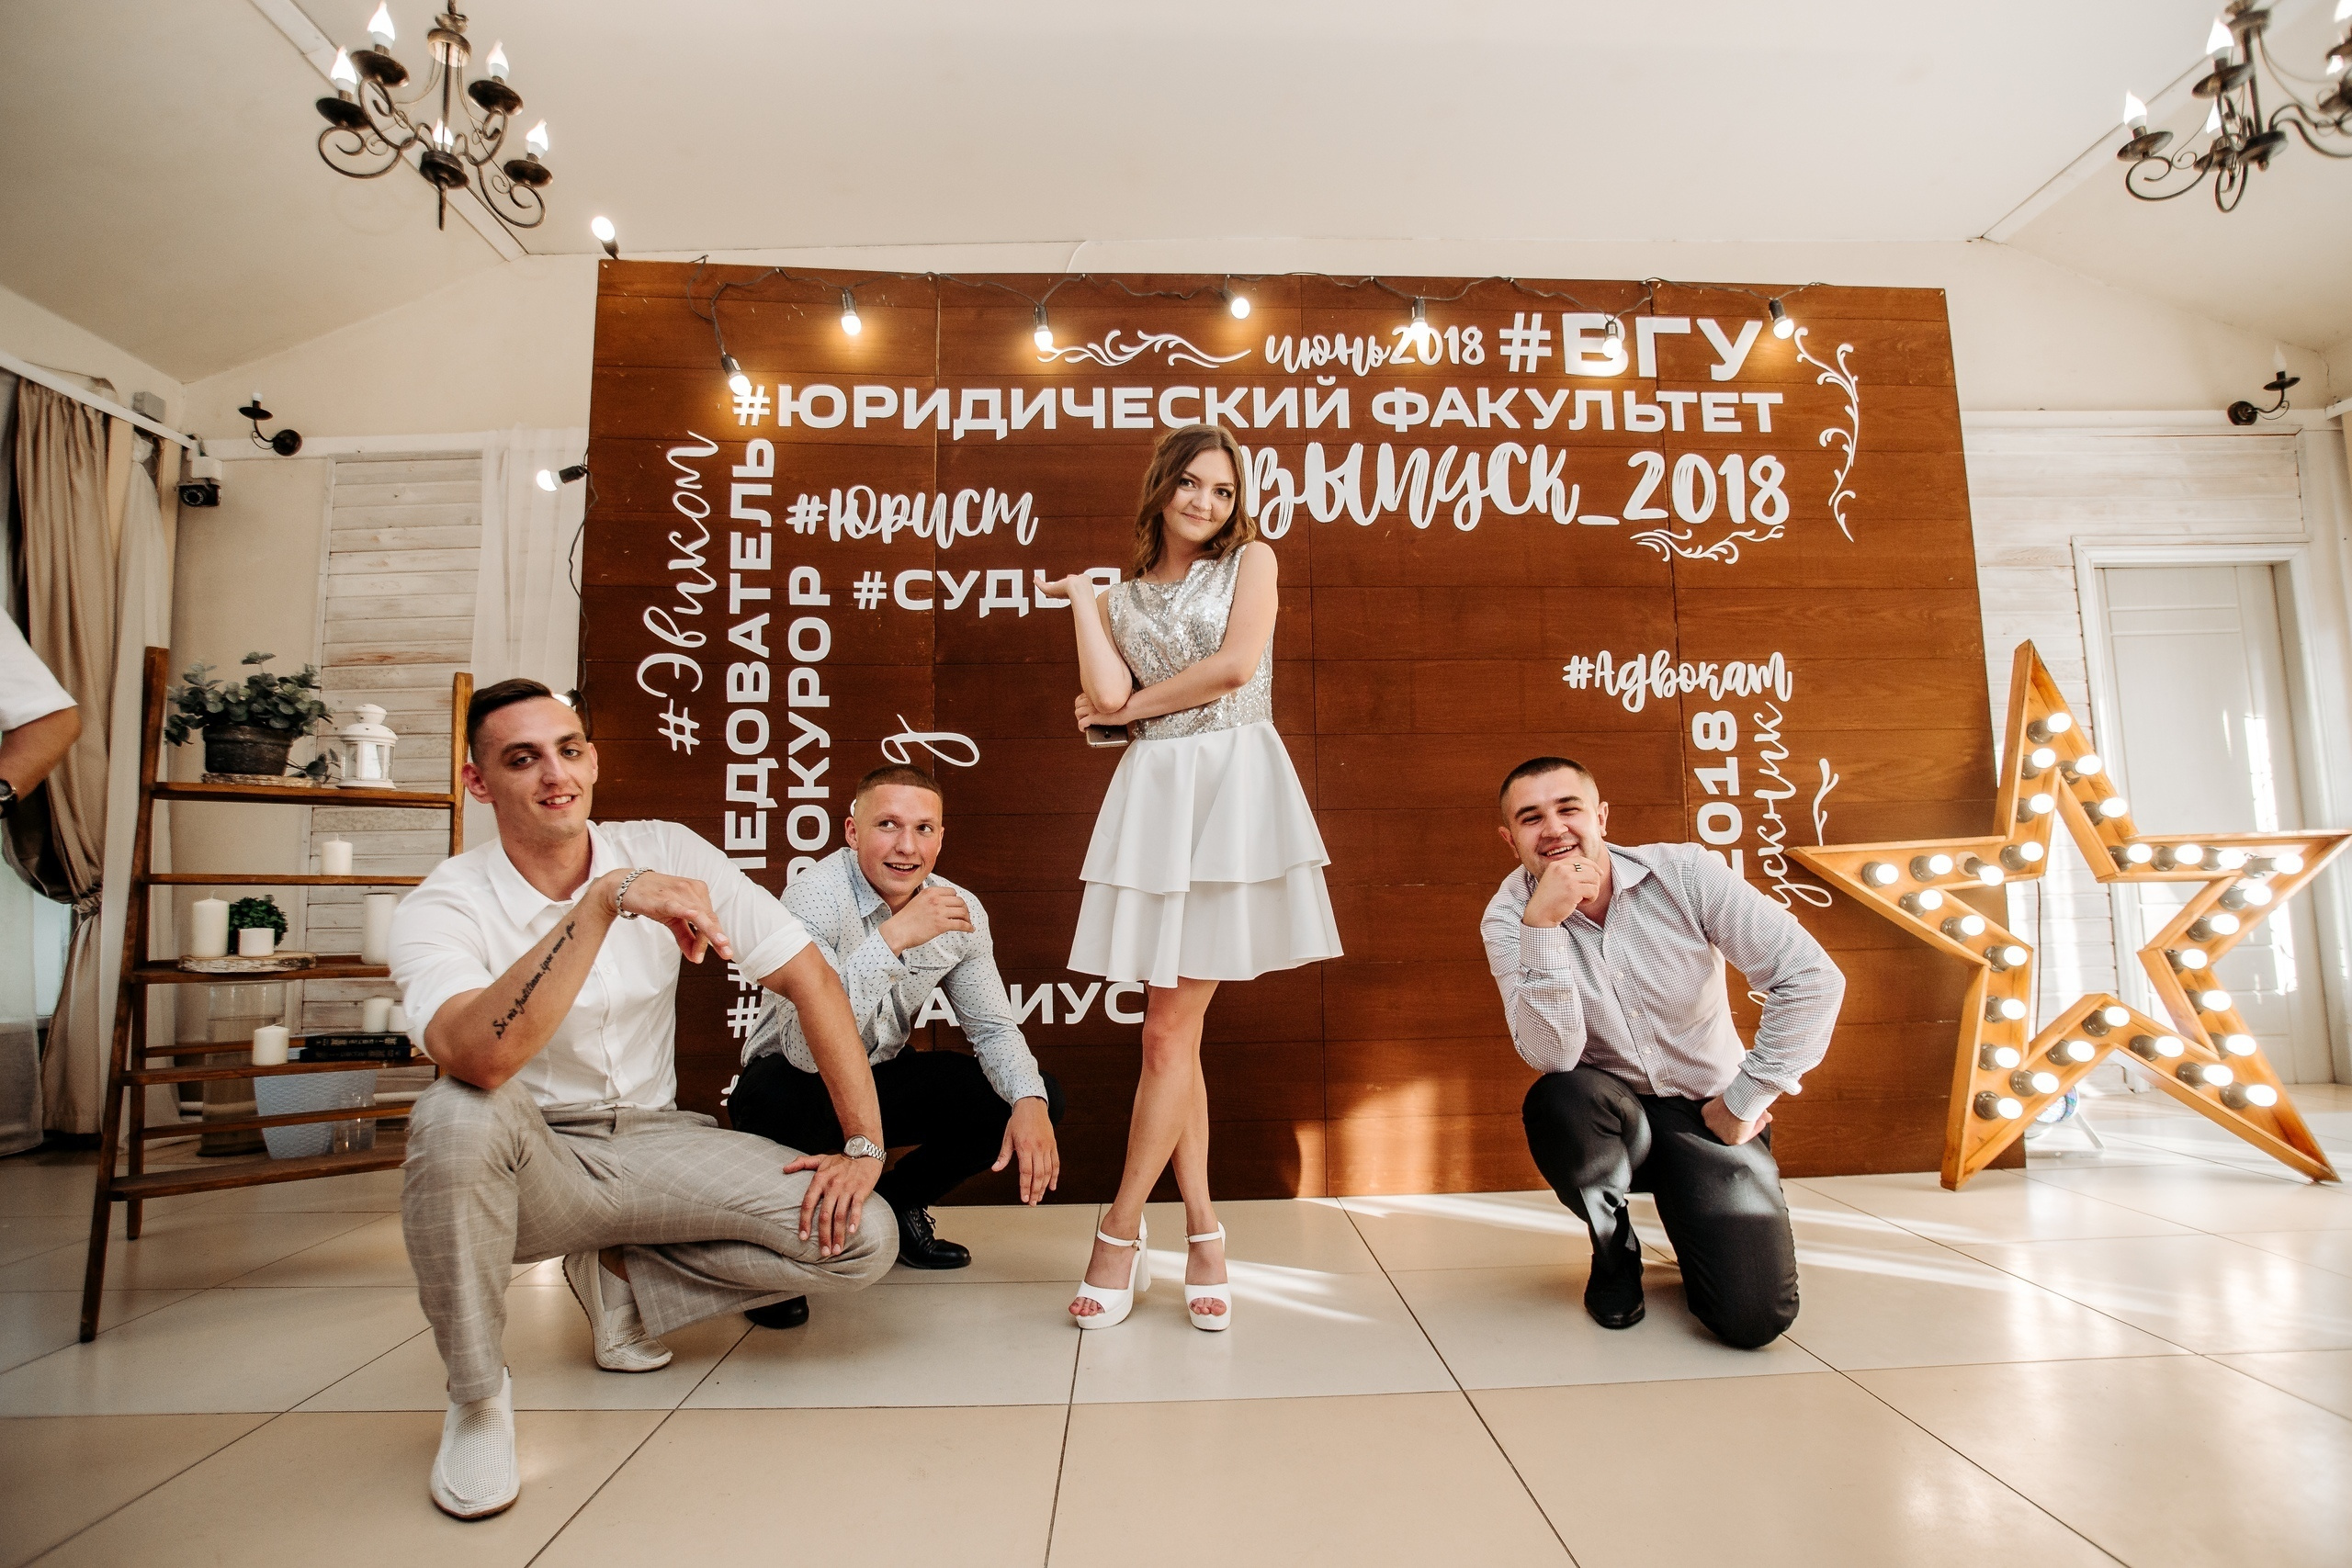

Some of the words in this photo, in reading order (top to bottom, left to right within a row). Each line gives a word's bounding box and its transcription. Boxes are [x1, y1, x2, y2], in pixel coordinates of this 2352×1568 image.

[1499, 312, 1763, 381] #ВГУ
[731, 375, 1350, 441] #ЮРИДИЧЕСКИЙ
[1371, 388, 1784, 434] ФАКУЛЬТЕТ
[786, 485, 1039, 549] #Юрист
[1562, 649, 1793, 714] #Адвокат
